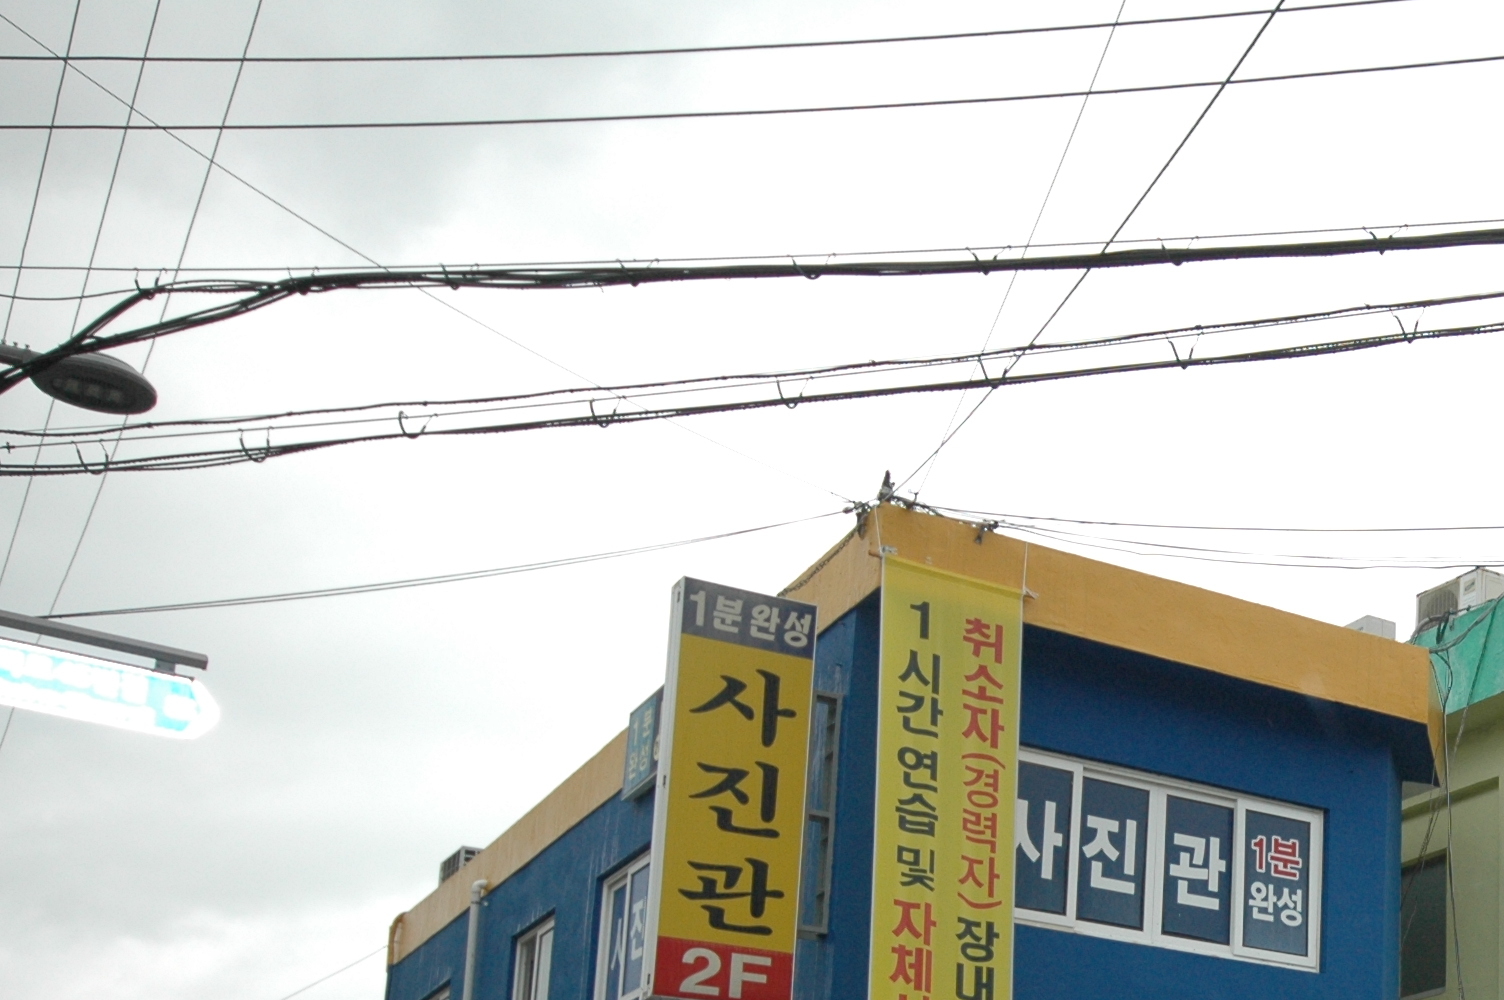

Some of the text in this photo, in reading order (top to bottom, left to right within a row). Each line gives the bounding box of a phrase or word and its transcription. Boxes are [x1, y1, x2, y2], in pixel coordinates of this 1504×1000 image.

[895, 746, 939, 838] 연습
[957, 617, 1006, 910] 취소자(경력자)
[677, 668, 798, 936] 사진관
[896, 844, 935, 891] 및
[1015, 798, 1226, 911] 사진관
[1251, 834, 1303, 881] 1분
[1248, 880, 1303, 928] 완성
[678, 946, 773, 1000] 2F
